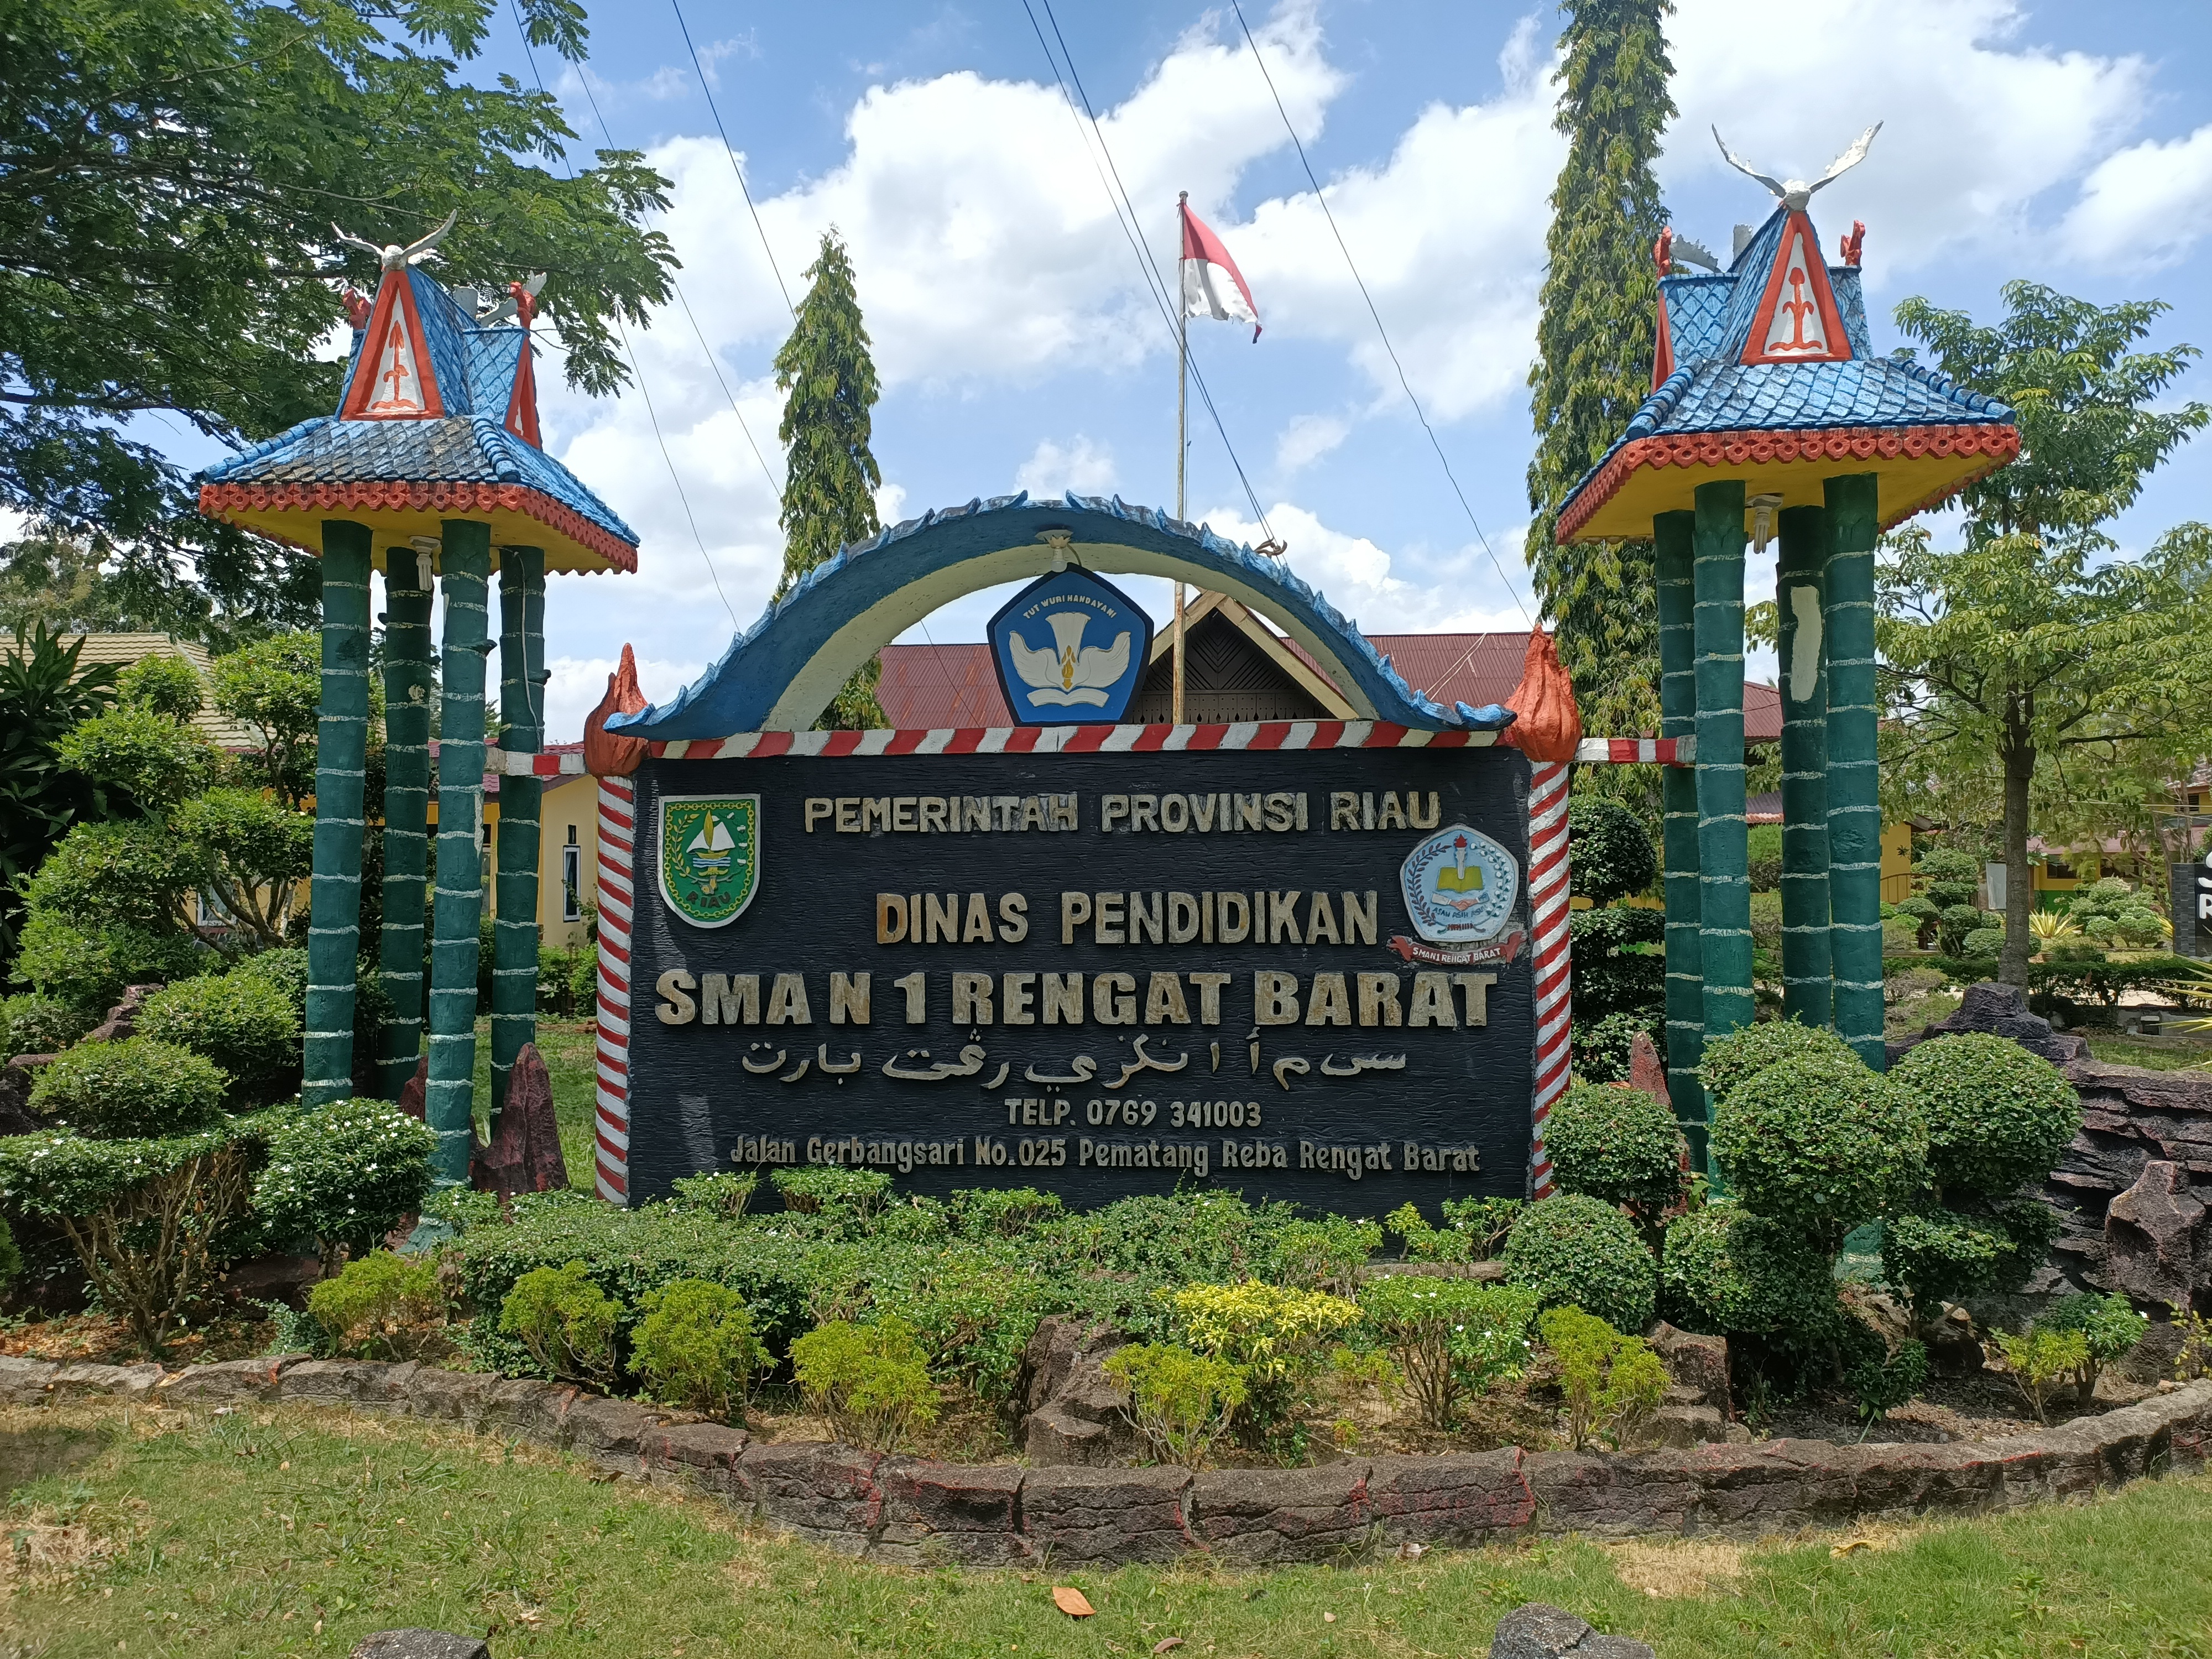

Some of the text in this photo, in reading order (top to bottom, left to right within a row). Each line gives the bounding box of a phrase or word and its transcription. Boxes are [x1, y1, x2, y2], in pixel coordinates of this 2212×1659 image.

[1023, 594, 1117, 619] TUT WURI HANDAYANI
[805, 791, 1440, 833] PEMERINTAH PROVINSI RIAU
[686, 890, 731, 909] RIAU
[876, 891, 1378, 945] DINAS PENDIDIKAN
[1473, 947, 1501, 961] BARAT
[894, 972, 926, 1024] 1
[952, 971, 1232, 1025] RENGAT
[1254, 972, 1498, 1027] BARAT
[1005, 1098, 1261, 1128] TELP. 0769 341003
[731, 1135, 795, 1163] Jalan
[806, 1136, 964, 1173] Gerbangsari
[1079, 1139, 1208, 1177] Pematang
[1222, 1139, 1288, 1168] Reba
[1300, 1140, 1392, 1180] Rengat
[1404, 1140, 1480, 1172] Barat
